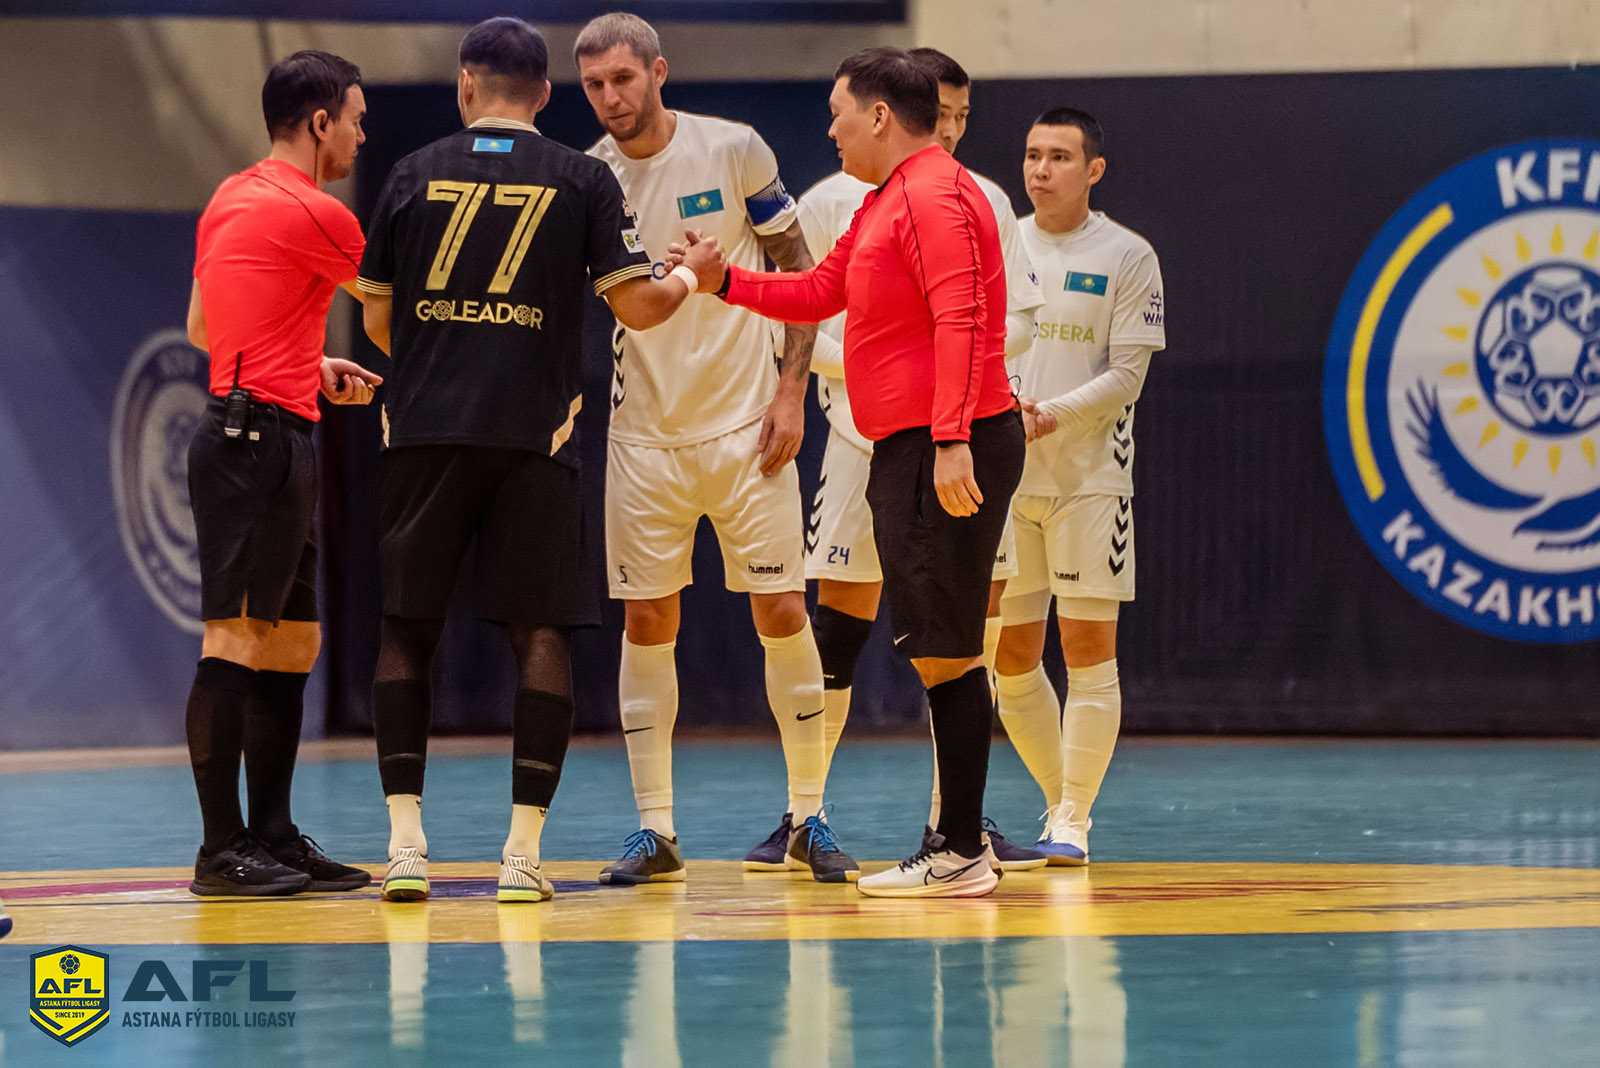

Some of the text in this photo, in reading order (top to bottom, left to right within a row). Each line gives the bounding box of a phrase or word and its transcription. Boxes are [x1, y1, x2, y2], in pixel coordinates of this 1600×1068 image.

[425, 180, 558, 295] 77
[415, 299, 544, 330] GOLEADOR
[1033, 321, 1095, 344] SFERA
[748, 562, 784, 575] hummel
[828, 546, 850, 565] 24
[1382, 509, 1600, 627] KAZAKH
